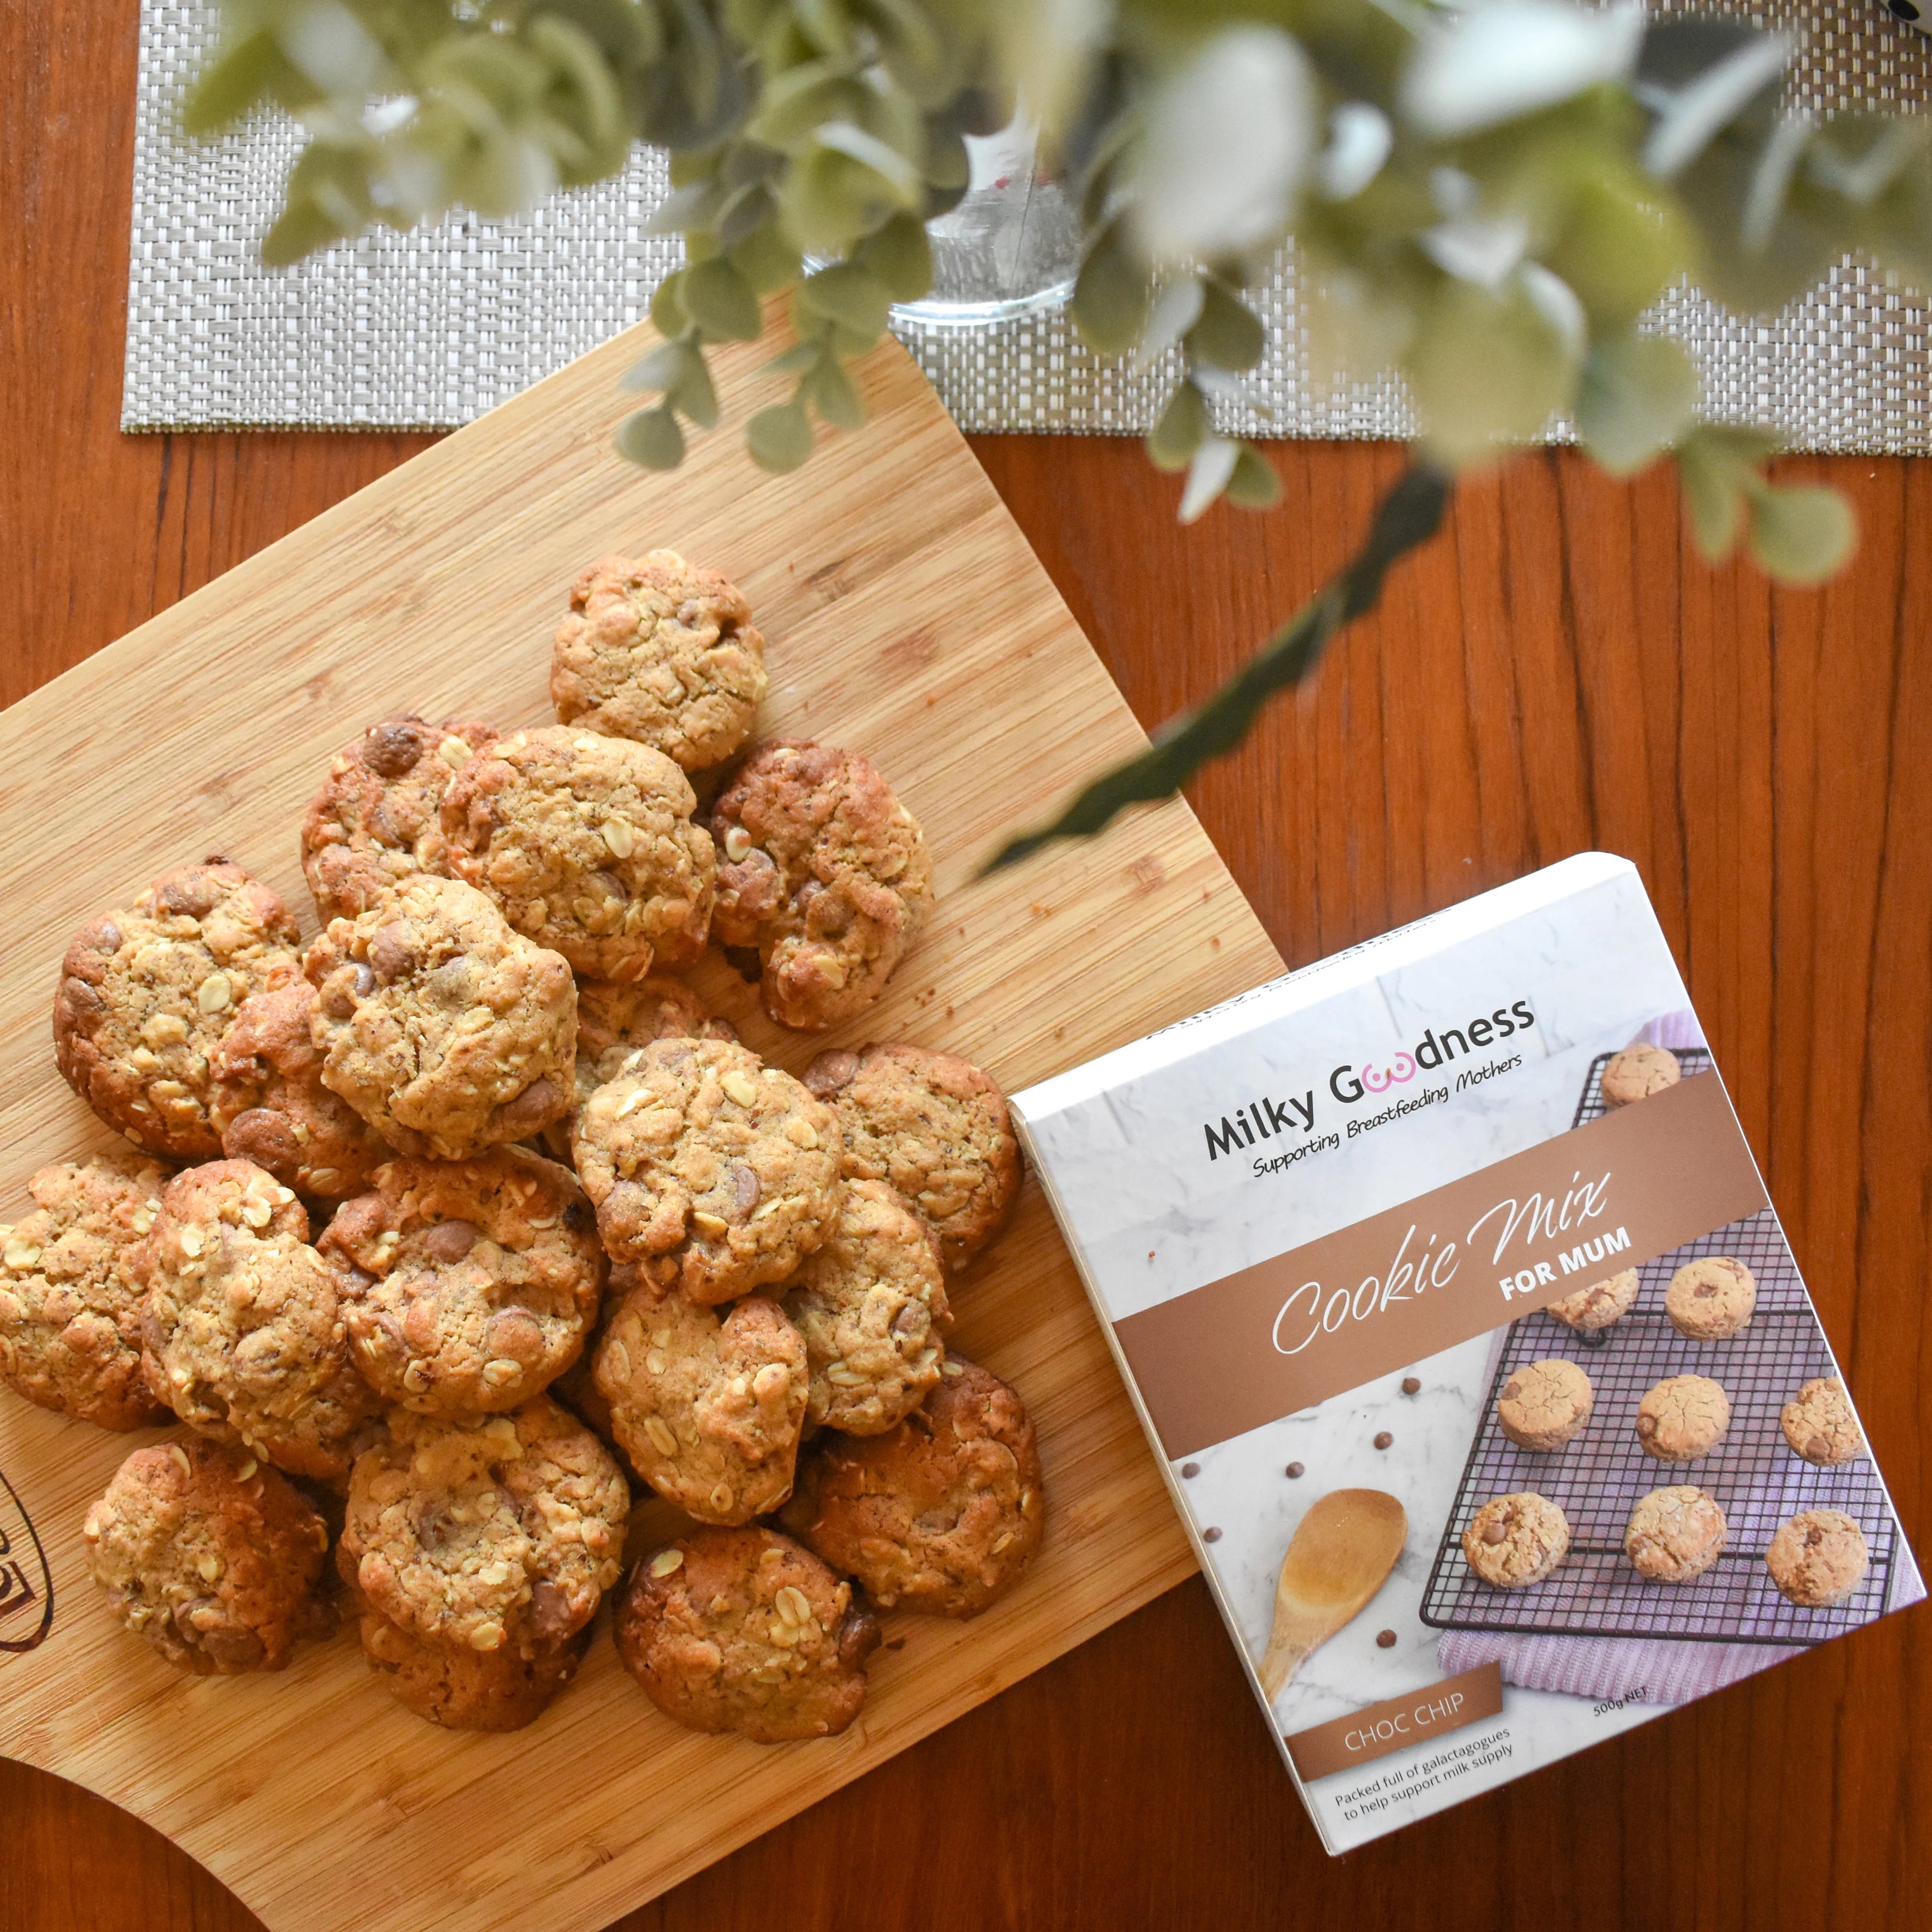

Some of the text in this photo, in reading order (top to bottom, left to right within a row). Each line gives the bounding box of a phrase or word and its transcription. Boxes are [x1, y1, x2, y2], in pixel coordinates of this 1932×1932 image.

[1203, 1000, 1535, 1162] Milky Goodness
[1252, 1054, 1522, 1178] Supporting Breastfeeding Mothers
[1272, 1171, 1611, 1354] Cookie Mix
[1499, 1226, 1632, 1301] FOR MUM
[1345, 1693, 1464, 1750] CHOC CHIP
[1593, 1685, 1647, 1717] 500g NET
[1335, 1728, 1510, 1807] Packed full of galactagogues
[1344, 1744, 1513, 1821] to help support milk supply
